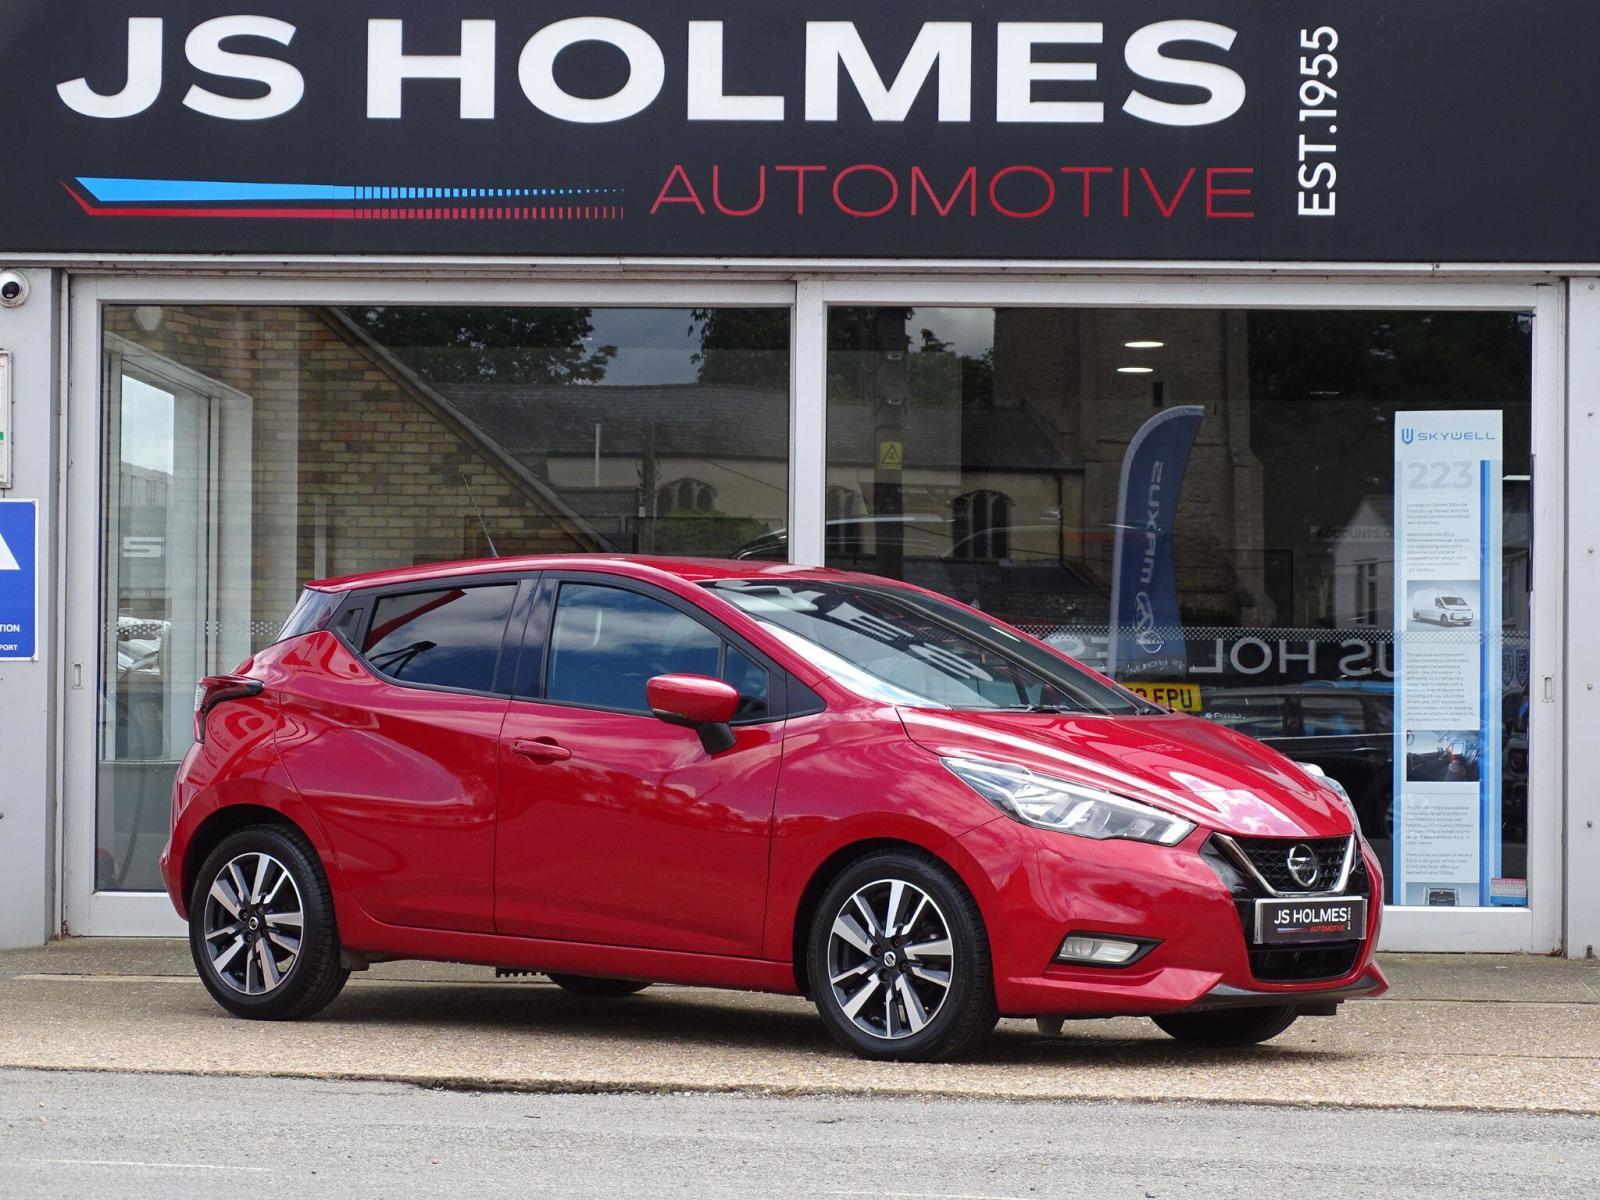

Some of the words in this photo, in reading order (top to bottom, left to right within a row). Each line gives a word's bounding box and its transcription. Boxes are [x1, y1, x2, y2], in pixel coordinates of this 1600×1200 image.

[56, 14, 305, 121] JS
[366, 15, 1247, 127] HOLMES
[1297, 25, 1339, 217] EST.1955
[650, 164, 1255, 219] AUTOMOTIVE
[1417, 431, 1496, 441] SKYWELL
[1407, 460, 1475, 490] 223
[1274, 908, 1290, 925] JS
[1293, 907, 1348, 924] HOLMES
[1310, 924, 1345, 932] AUTOMOTIVE
